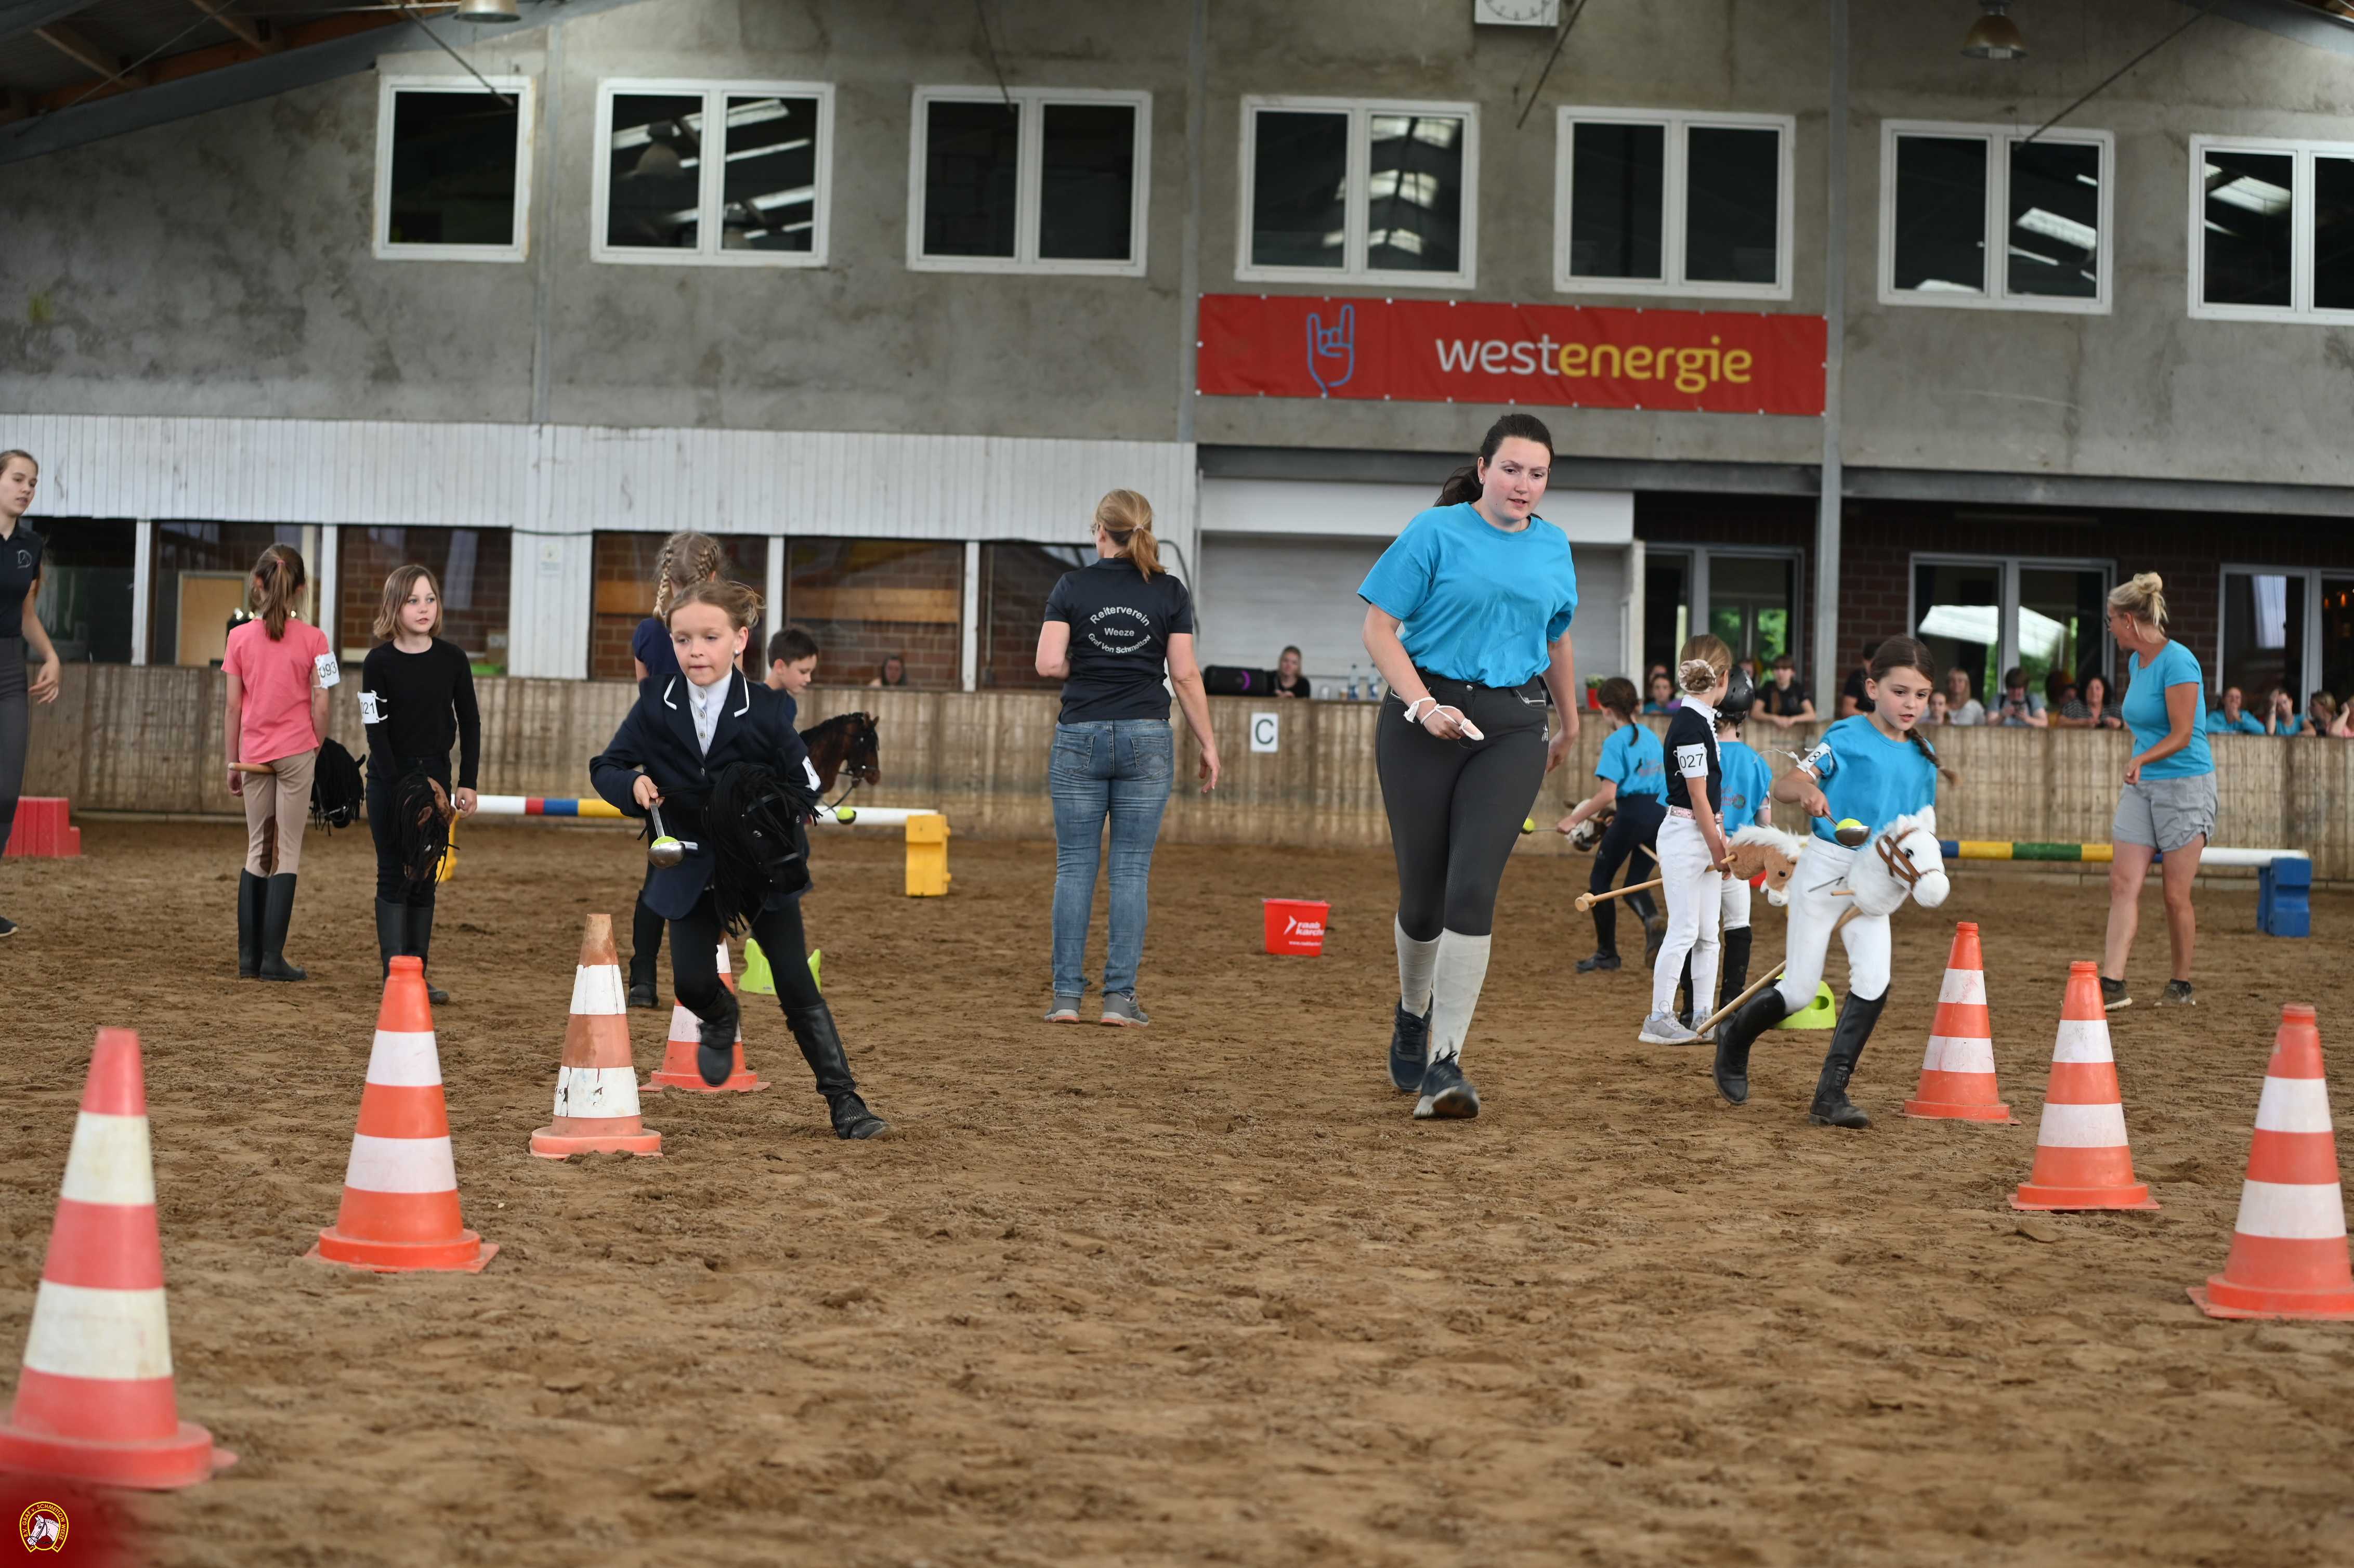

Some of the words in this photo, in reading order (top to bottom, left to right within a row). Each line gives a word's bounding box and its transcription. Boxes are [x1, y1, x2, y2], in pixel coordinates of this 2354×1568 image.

[1435, 334, 1752, 394] westenergie
[1090, 606, 1149, 626] Reiterverein
[1104, 628, 1134, 636] Weeze
[1088, 633, 1102, 646] Graf
[1102, 643, 1114, 653] Von
[1116, 634, 1151, 654] Schmettow
[319, 661, 337, 678] 093
[1254, 719, 1274, 744] C
[1679, 753, 1704, 768] 027
